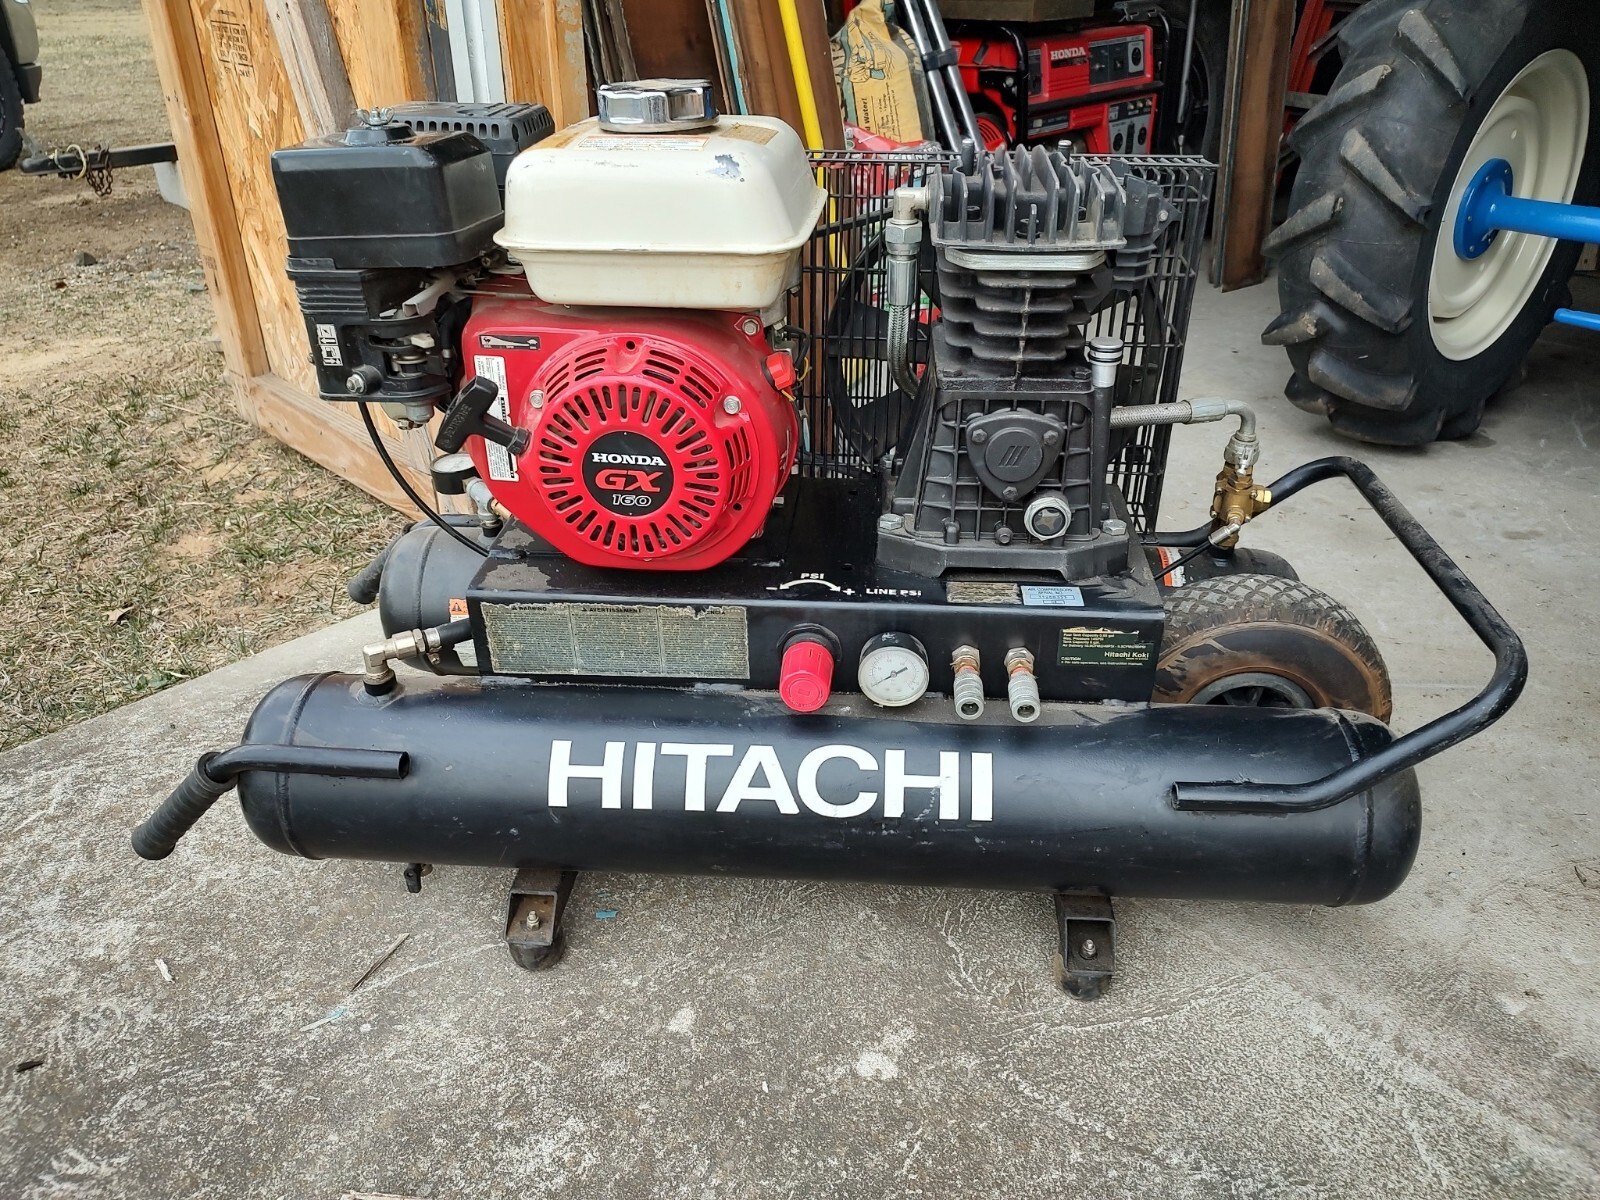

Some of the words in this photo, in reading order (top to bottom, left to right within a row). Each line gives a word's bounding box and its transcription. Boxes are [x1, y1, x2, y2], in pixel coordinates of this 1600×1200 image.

[1050, 46, 1086, 60] HONDA
[591, 452, 667, 467] HONDA
[595, 468, 664, 493] GX
[612, 493, 652, 507] 160
[865, 588, 897, 596] LINE
[899, 588, 922, 596] PSI
[547, 739, 993, 822] HITACHI
